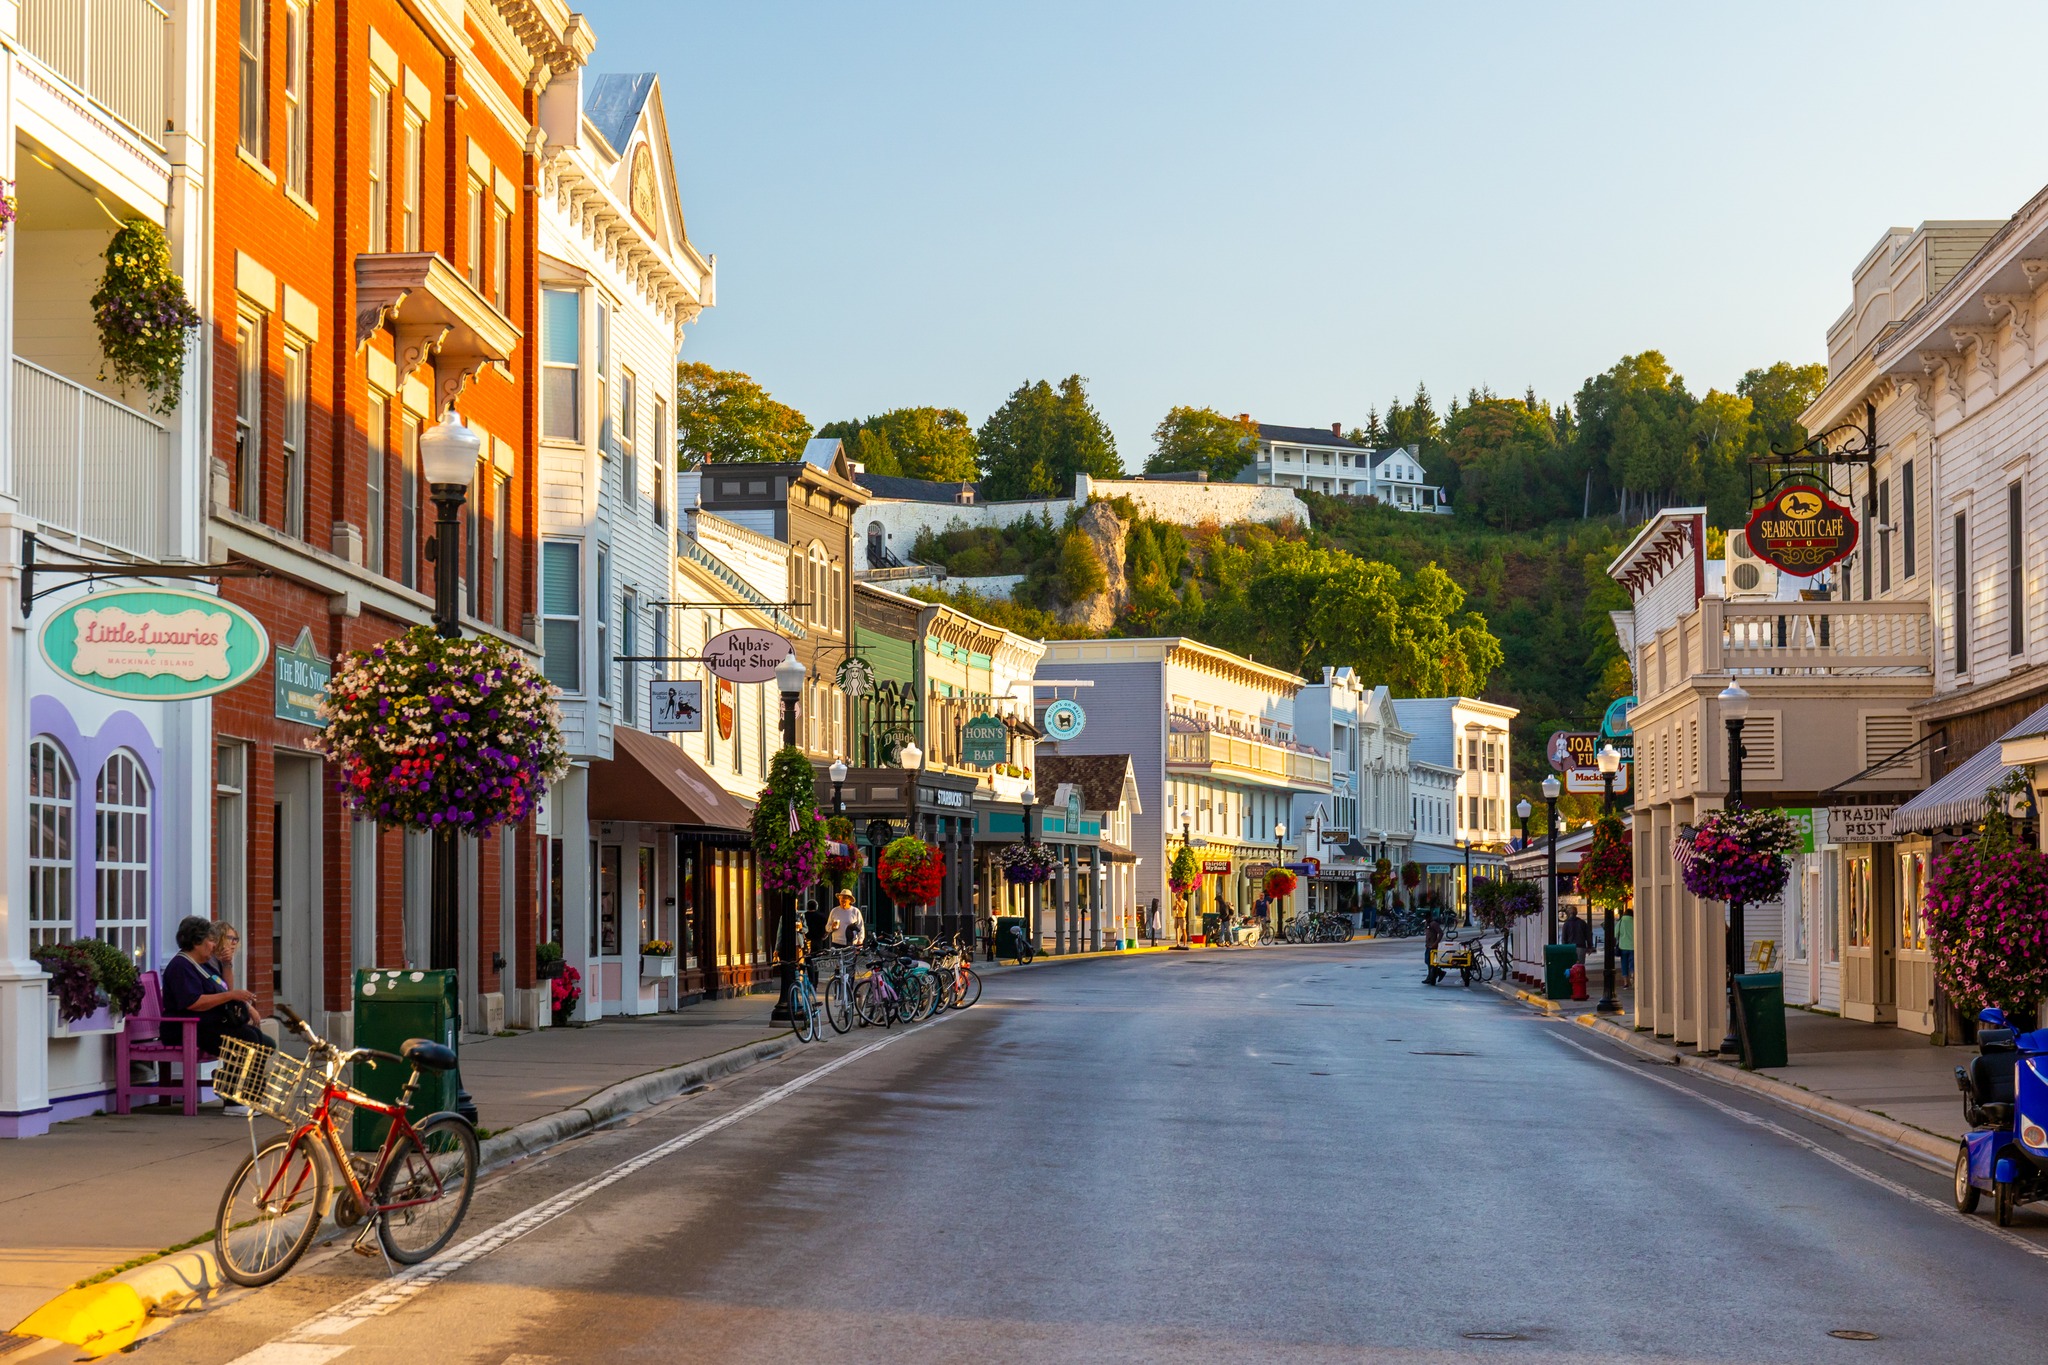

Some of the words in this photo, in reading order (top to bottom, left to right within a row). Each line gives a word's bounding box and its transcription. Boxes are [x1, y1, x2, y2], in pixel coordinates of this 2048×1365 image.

[1761, 519, 1816, 538] SEABISCUIT
[1817, 515, 1844, 537] CAFÉ
[85, 620, 137, 644] Little
[138, 622, 219, 647] Luxuries
[728, 633, 770, 656] Ryba's
[107, 657, 156, 666] MACKINAC
[160, 659, 194, 667] ISLAND
[709, 652, 746, 672] Fudge
[749, 653, 786, 668] Shop
[294, 660, 308, 688] BIG
[1048, 702, 1063, 718] Millie's
[1073, 705, 1082, 719] Main
[965, 727, 1004, 739] HORN'S
[1567, 737, 1597, 752] JOA
[974, 750, 995, 761] BAR
[937, 789, 962, 807] STARBUCKS
[1845, 821, 1886, 836] POST
